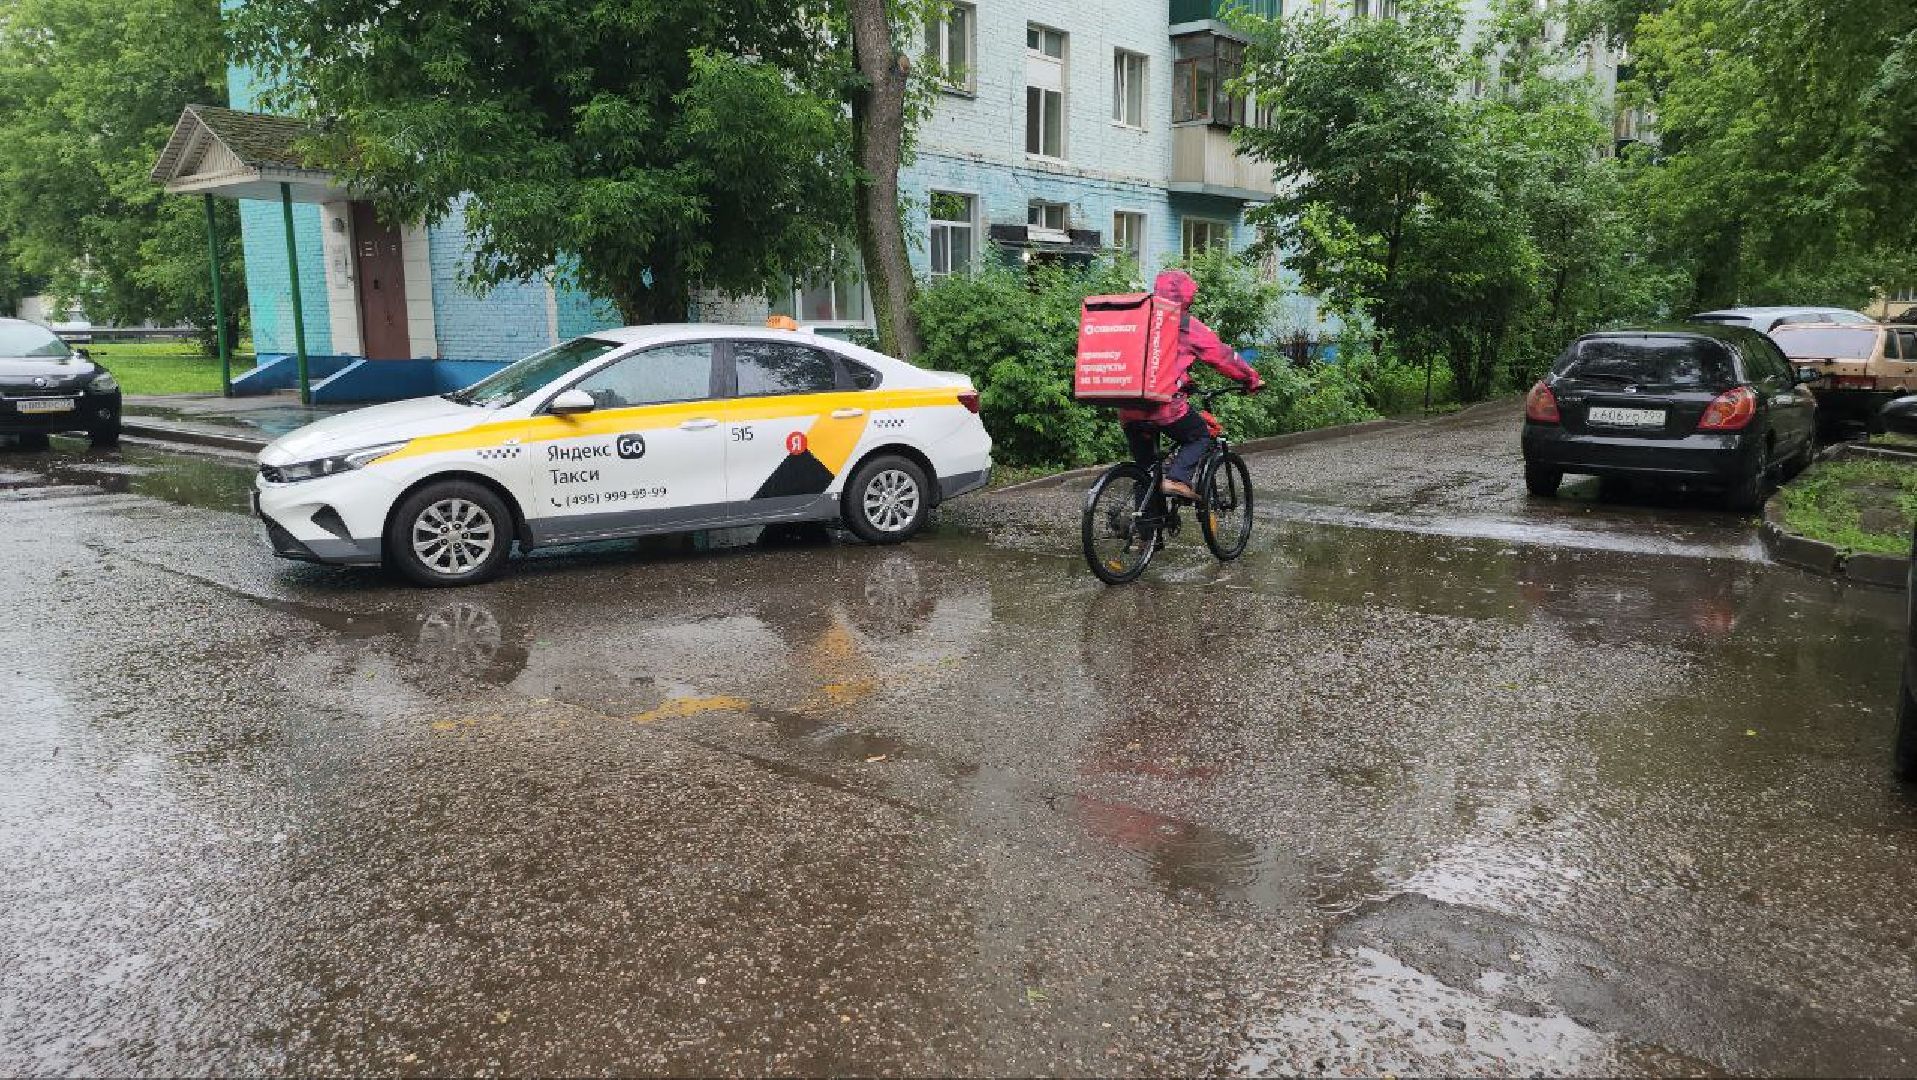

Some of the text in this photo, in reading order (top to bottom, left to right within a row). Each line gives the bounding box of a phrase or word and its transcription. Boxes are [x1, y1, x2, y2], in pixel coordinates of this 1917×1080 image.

[731, 426, 754, 441] 515
[547, 437, 644, 461] Яндекс Go
[549, 469, 600, 486] Такси
[566, 486, 667, 507] (495) 999-99-99
